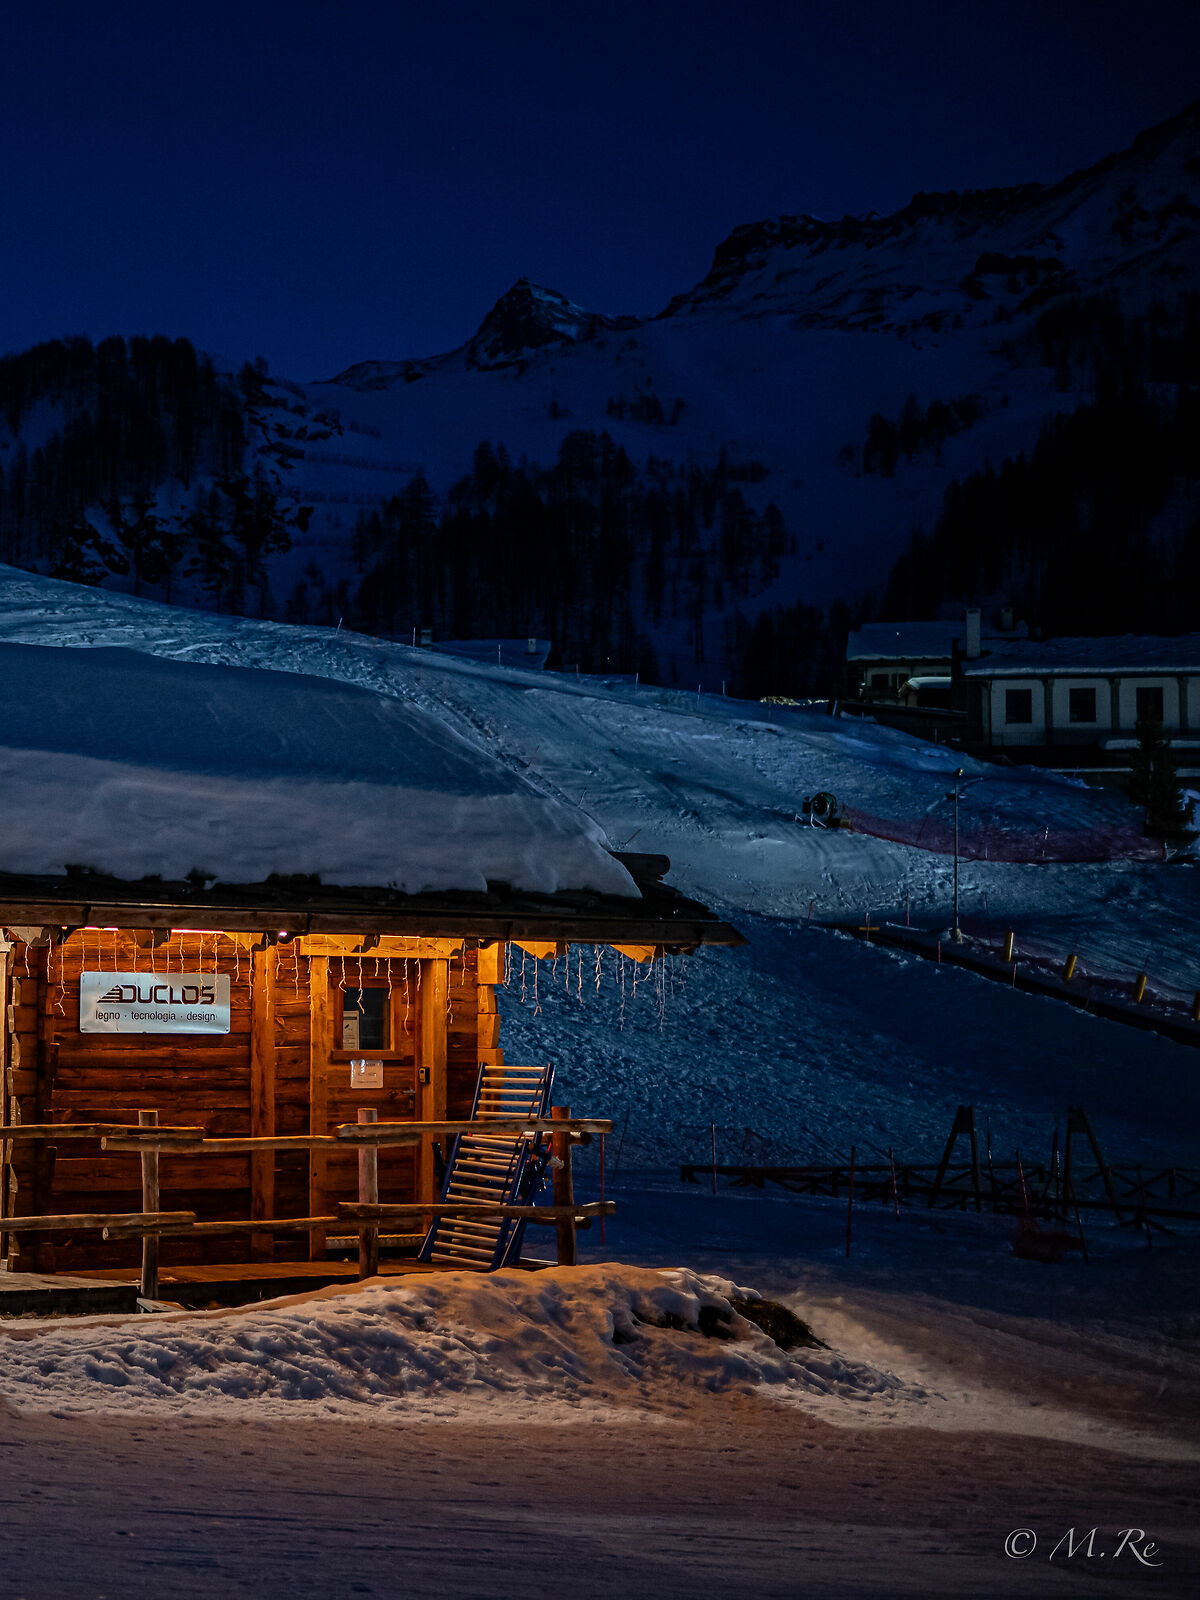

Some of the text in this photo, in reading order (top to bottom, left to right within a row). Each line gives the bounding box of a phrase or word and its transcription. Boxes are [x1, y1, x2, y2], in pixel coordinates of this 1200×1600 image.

[109, 984, 216, 1005] DUCLOS
[95, 1010, 216, 1023] legno tecnologia design
